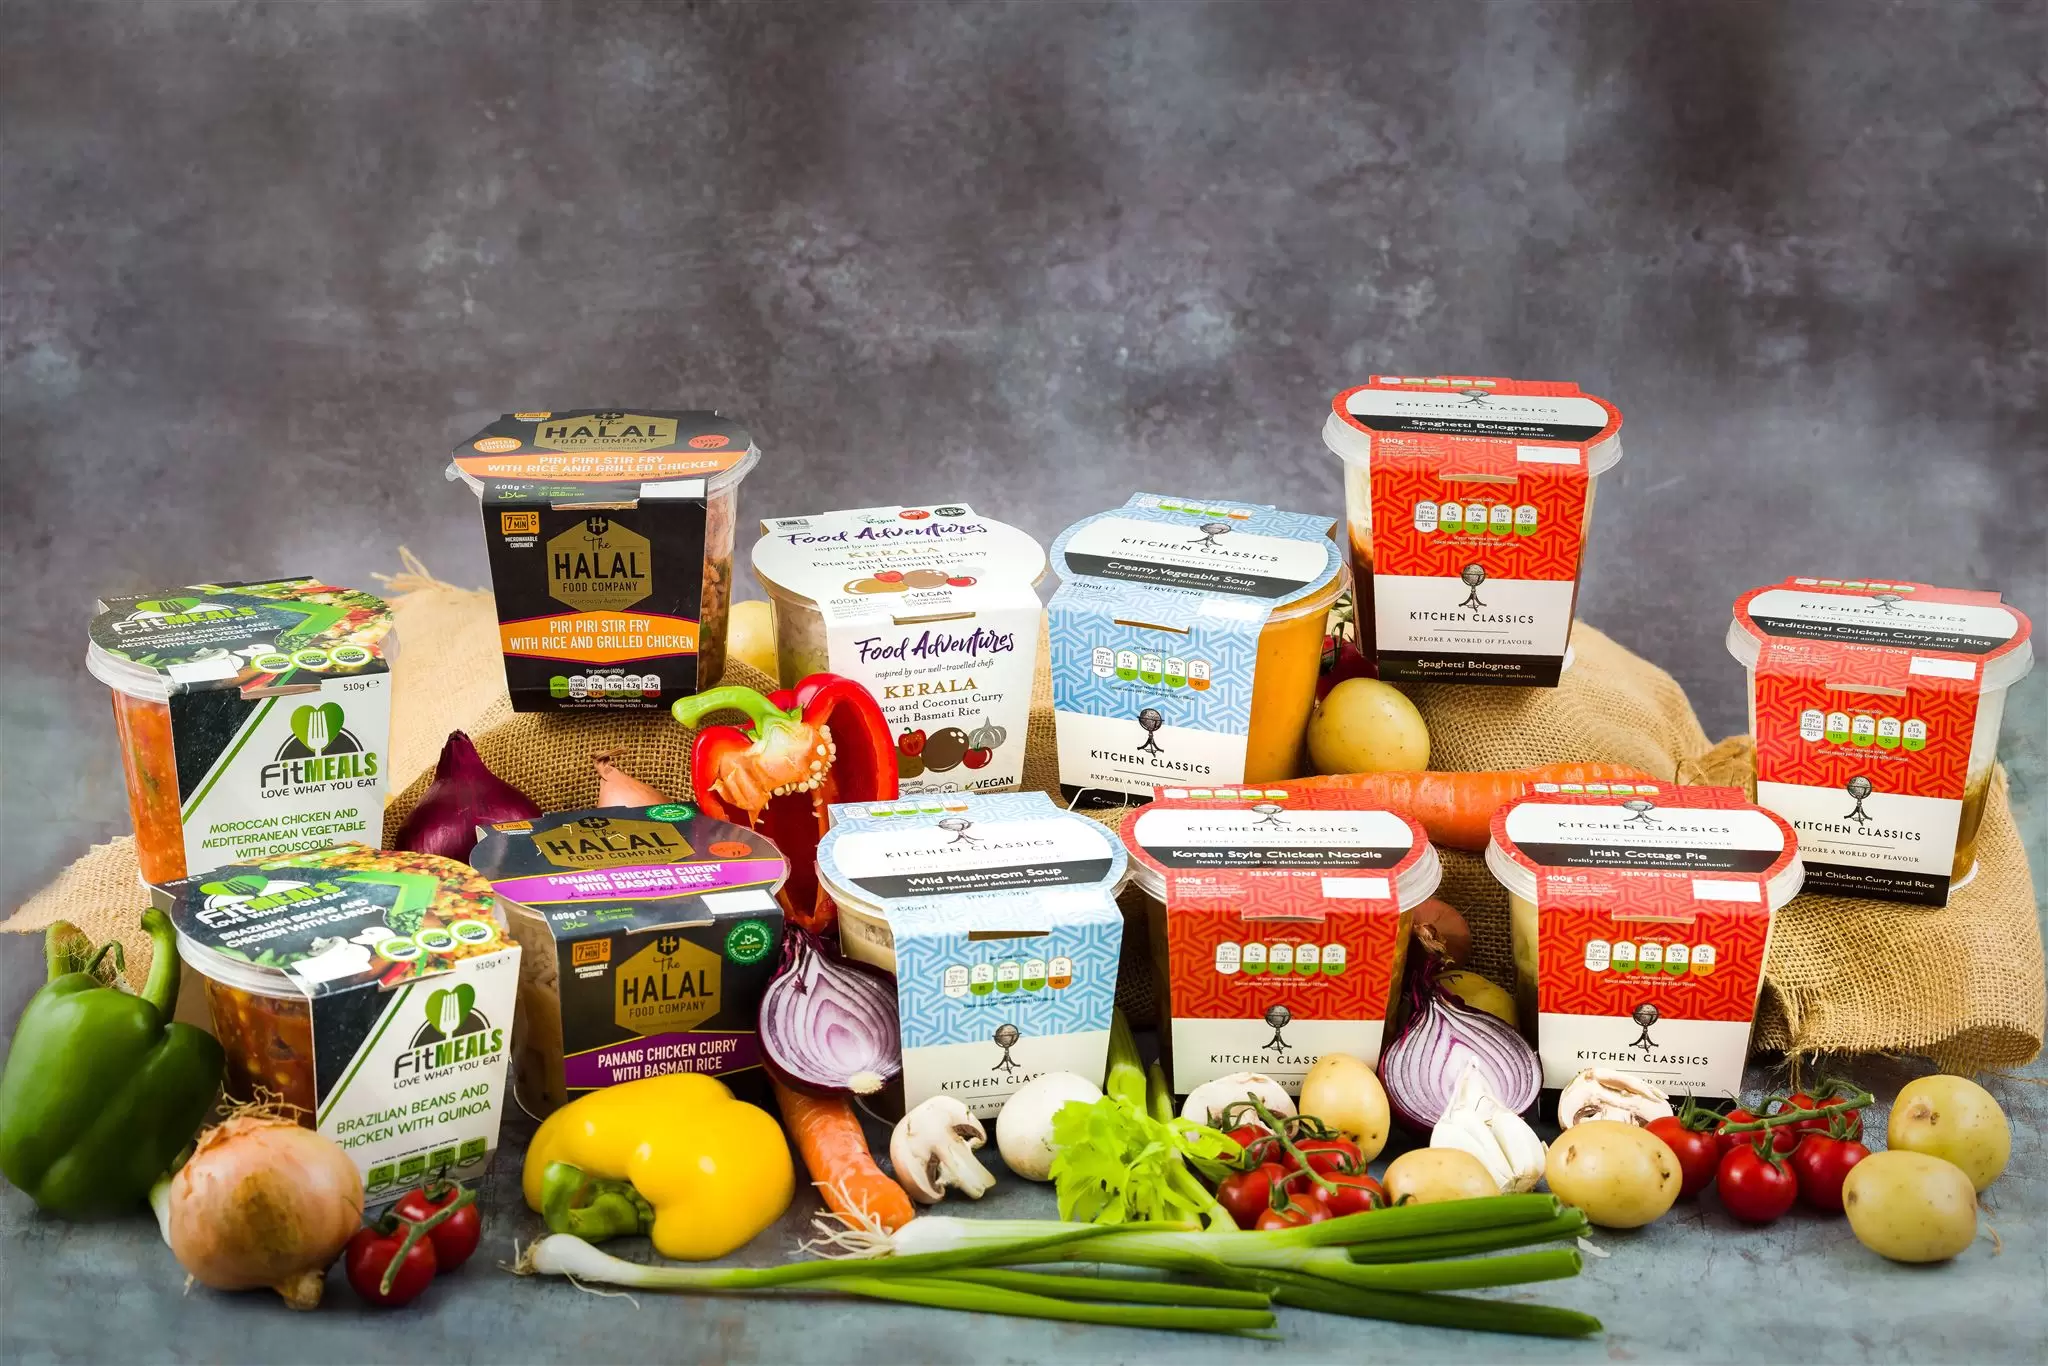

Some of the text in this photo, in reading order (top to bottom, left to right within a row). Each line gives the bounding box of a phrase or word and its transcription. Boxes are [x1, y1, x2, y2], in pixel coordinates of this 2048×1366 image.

[544, 424, 668, 439] HALAL
[1411, 419, 1545, 433] Spaghetti Bolognese
[1378, 437, 1404, 445] 400g
[540, 455, 665, 466] PIRI PIRI STIR FRY
[495, 483, 520, 492] 400g
[507, 516, 513, 530] 7
[513, 522, 528, 530] MIN
[778, 522, 989, 547] Food Adventures
[583, 536, 612, 550] The
[847, 547, 941, 559] KERALA
[554, 552, 645, 580] HALAL
[1107, 562, 1256, 587] Creamy Vegetable Soup
[562, 582, 638, 592] FOOD COMPANY
[911, 590, 953, 599] VEGAN
[1409, 611, 1535, 624] KITCHEN CLASSICS
[550, 619, 650, 633] PIRI PIRI STIR FRY
[1765, 619, 1992, 647] Traditional Chicken Curry and Rice
[153, 633, 253, 650] WITH COUSCOUS
[510, 635, 694, 650] WITH RICE AND GRILLED CHICKEN
[854, 627, 1015, 665] Food Adventures
[1497, 638, 1533, 646] FLAVOUR
[1770, 644, 1796, 653] 400g
[875, 669, 903, 680] inspired
[904, 668, 913, 678] by
[927, 661, 977, 674] well-travelled
[977, 659, 995, 668] chefs
[1417, 659, 1521, 671] Spaghetti Bolognese
[343, 682, 365, 691] 510g
[884, 677, 978, 700] KERALA
[880, 692, 1004, 713] ato and Coconut Curry
[887, 706, 981, 724] with Basmati Rice
[260, 752, 378, 789] FitMEALS
[1090, 750, 1211, 775] KITCHEN CLASSICS
[261, 778, 378, 799] LOVE WHAT YOU EAT
[975, 776, 1014, 789] VEGAN
[209, 808, 358, 834] MOROCCAN CHICKEN AND
[1558, 821, 1731, 834] KITCHEN CLASSICS
[202, 821, 366, 849] MEDITERRANEAN VEGETABLE
[1793, 820, 1921, 841] KITCHEN CLASSICS
[235, 838, 334, 858] WITH COUSCOUS
[546, 831, 680, 856] HALAL
[1172, 850, 1382, 862] Korean Style Chicken Noodle
[1567, 857, 1595, 865] freshly
[1650, 860, 1693, 868] deliciously
[1589, 848, 1707, 862] Irish Cottage Pie
[1838, 850, 1867, 858] WORLD
[1883, 854, 1920, 863] FLAVOUR
[547, 864, 723, 886] PANANG CHICKEN CURRY
[575, 882, 613, 893] WITH
[614, 877, 679, 889] BASMATI
[681, 873, 714, 884] RICE
[907, 866, 1062, 886] Wild Mushroom Soup
[1175, 877, 1202, 885] 400g
[1545, 874, 1573, 884] 400g
[1621, 871, 1662, 879] SERVES
[1825, 871, 1935, 889] Chicken Curry and Rice
[225, 904, 386, 948] CHICKEN WITH QUINOA
[475, 960, 496, 971] 510g
[653, 956, 681, 972] The
[623, 970, 714, 1006] HALAL
[629, 1000, 706, 1018] FOOD COMPANY
[394, 1028, 503, 1079] FitMEALS
[598, 1039, 738, 1068] PANANG CHICKEN CURRY
[1210, 1055, 1318, 1065] KITCHEN CLASS
[1577, 1050, 1709, 1066] KITCHEN CLASSICS
[394, 1054, 501, 1090] LOVE WHAT YOU EAT
[612, 1056, 722, 1082] WITH BASMATI RICE
[941, 1077, 999, 1091] KITCHEN
[336, 1083, 489, 1134] BRAZILIAN BEANS AND
[398, 1116, 434, 1135] WITH
[437, 1100, 491, 1123] QUINOA
